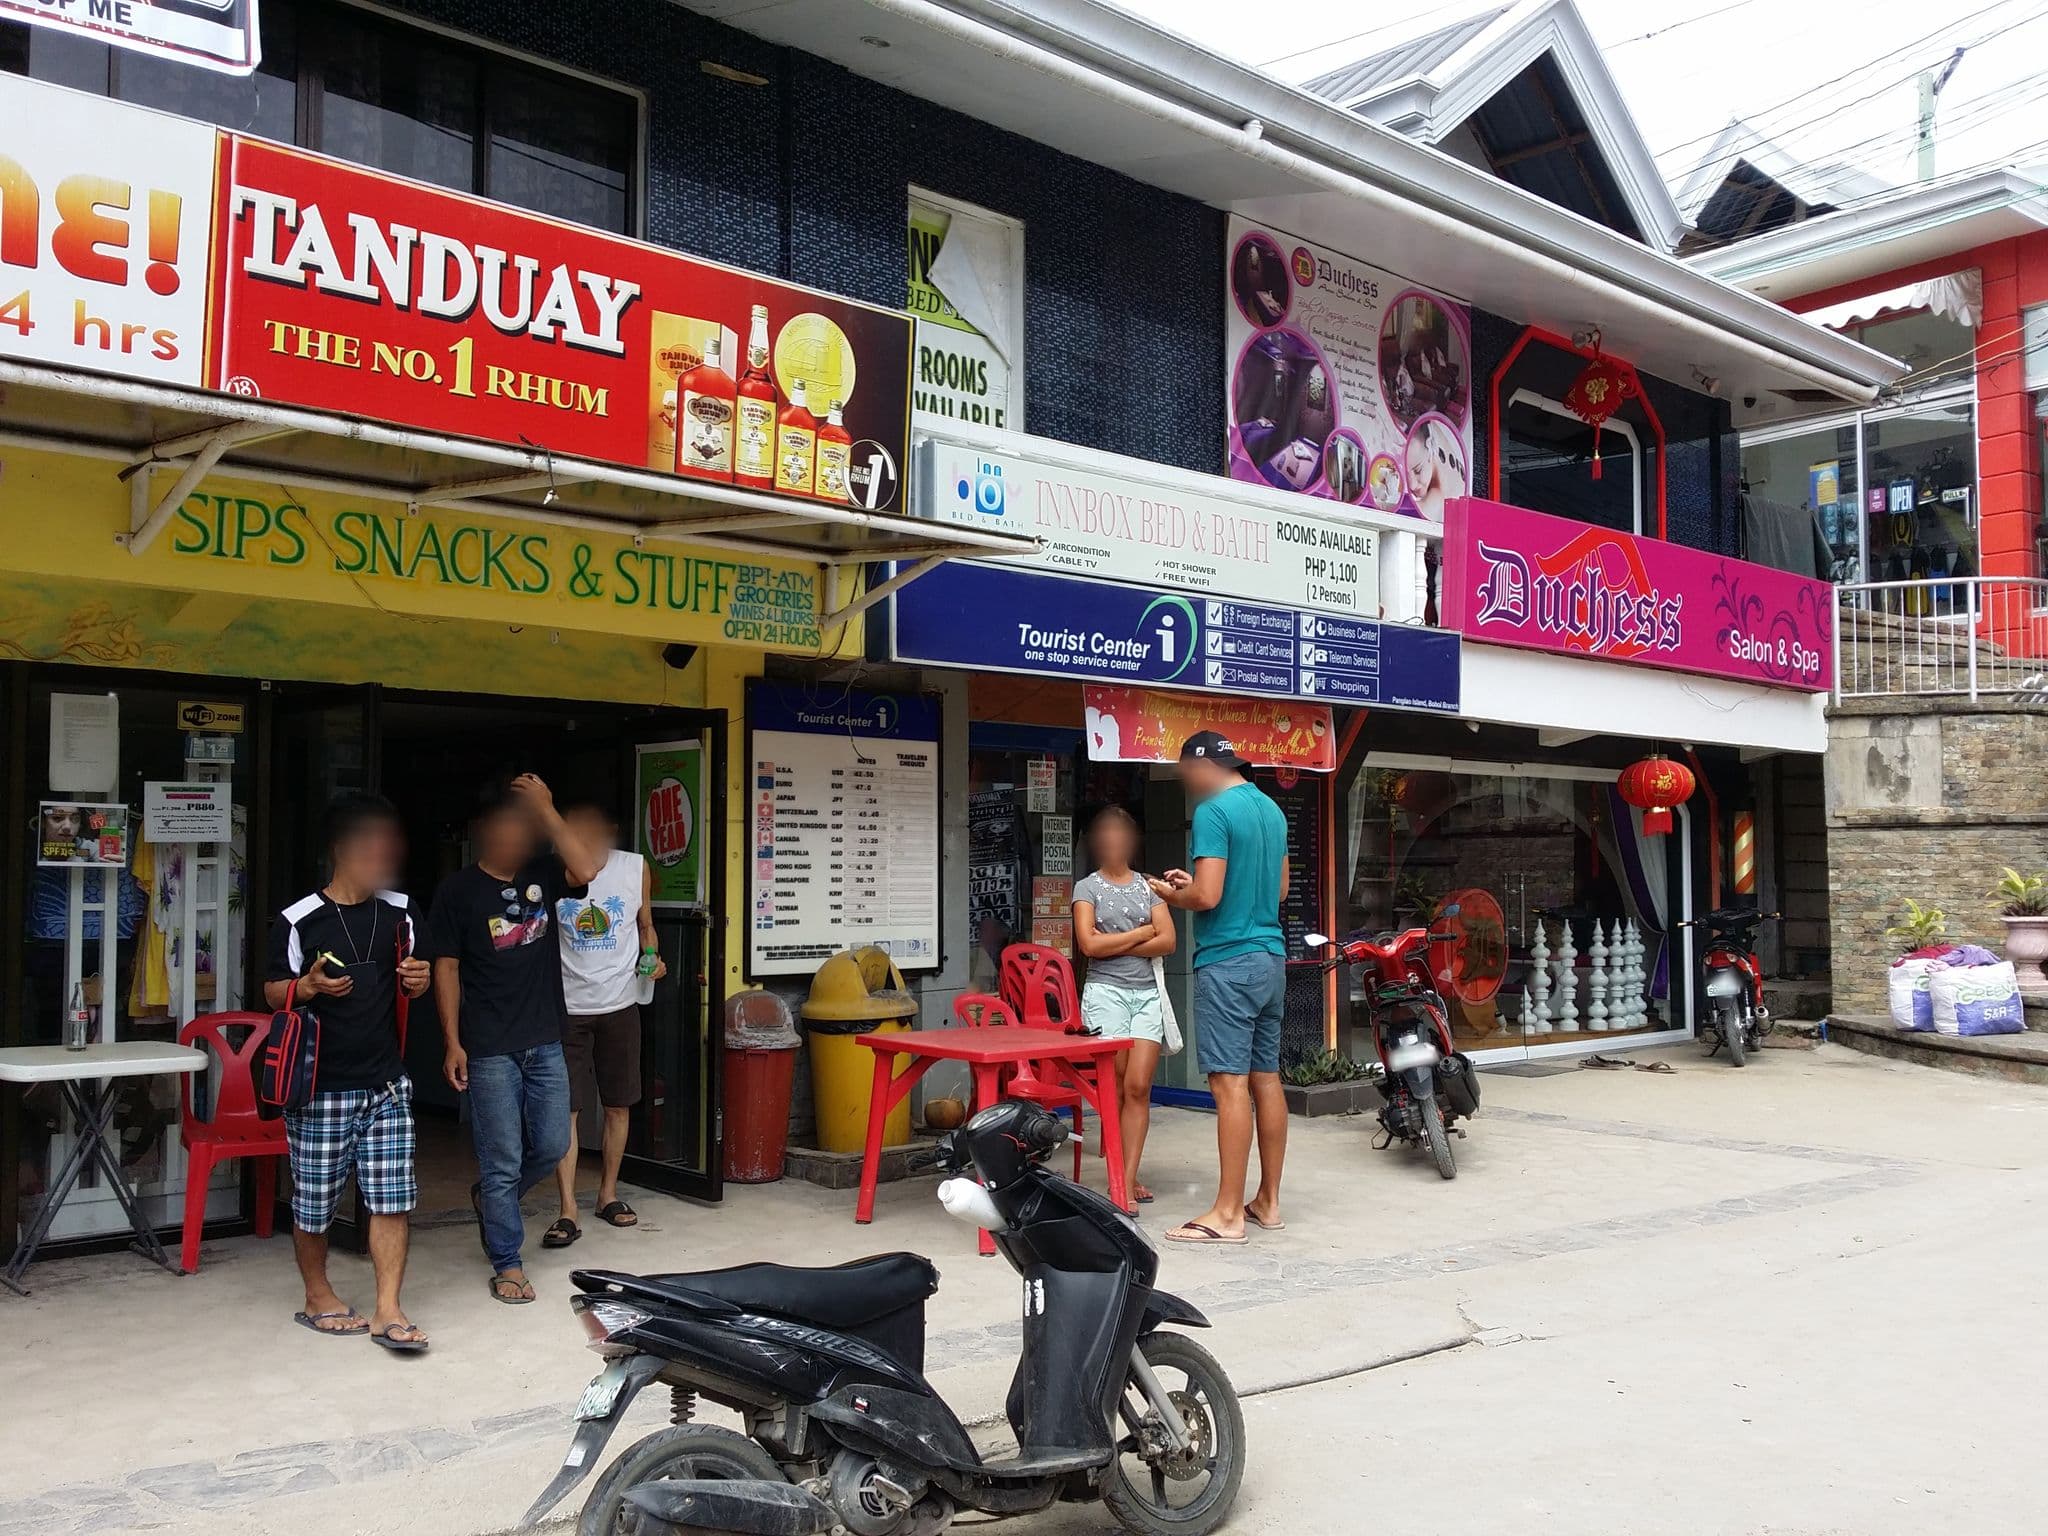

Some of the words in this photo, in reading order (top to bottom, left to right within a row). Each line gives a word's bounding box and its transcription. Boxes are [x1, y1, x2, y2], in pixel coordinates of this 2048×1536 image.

[234, 185, 641, 356] TANDUAY
[1317, 257, 1379, 299] Duchess
[73, 299, 180, 362] hrs
[264, 319, 361, 368] THE
[484, 366, 610, 418] RHUM
[920, 345, 988, 397] ROOMS
[1892, 484, 1914, 512] OPEN
[952, 511, 974, 522] BED
[995, 518, 1025, 529] BATH
[1035, 480, 1134, 541] INNBOX
[1140, 499, 1187, 549] BED
[1193, 510, 1207, 553] &
[1212, 513, 1271, 565] BATH
[1276, 521, 1317, 547] ROOMS
[1319, 529, 1372, 557] AVAILABLE
[173, 493, 308, 566] SIPS
[334, 510, 552, 594] SNACKS
[568, 543, 604, 599] &
[614, 549, 737, 614] STUFF
[1052, 542, 1111, 559] AIRCONDITION
[1052, 555, 1082, 567] CABLE
[1084, 559, 1098, 569] TV
[1162, 560, 1181, 571] HOT
[1181, 563, 1217, 576] SHOWER
[1305, 557, 1327, 578] PHP
[1329, 562, 1358, 585] 1,100
[737, 564, 815, 593] BPI-ATM
[1162, 572, 1187, 584] FREE
[1188, 576, 1210, 587] WIFI
[734, 585, 815, 610] GROCERIES
[1476, 540, 1683, 652] Duchess
[730, 603, 765, 621] WINES
[766, 607, 773, 620] &
[774, 608, 815, 626] LIQUORS
[1236, 610, 1261, 626] Foreign
[1261, 614, 1292, 632] Exchange
[724, 619, 762, 640] OPEN
[763, 624, 777, 643] 24
[780, 625, 820, 648] HOURS
[1018, 624, 1086, 652] Tourist
[1091, 633, 1151, 660] Center
[1328, 624, 1357, 640] Business
[1356, 629, 1378, 642] Center
[1025, 650, 1045, 661] one
[1047, 652, 1070, 666] stop
[1072, 655, 1108, 668] service
[1110, 660, 1141, 672] center
[1237, 640, 1254, 653] Credit
[1255, 643, 1269, 656] Card
[1269, 645, 1292, 660] Services
[1329, 651, 1352, 666] Telecom
[1352, 654, 1377, 669] Services
[1730, 629, 1773, 665] Salon
[1777, 641, 1788, 666] &
[1791, 641, 1820, 682] Spa
[1237, 672, 1259, 683] Postal
[1260, 673, 1288, 687] Services
[1331, 680, 1370, 695] Shopping
[216, 713, 242, 722] ZONE
[797, 712, 835, 725] Tourist
[838, 715, 873, 728] Center
[1218, 701, 1248, 722] Chinese
[896, 753, 928, 761] TRAVELERS
[650, 784, 683, 828] ONE
[1044, 819, 1070, 831] INTERNET
[651, 821, 686, 855] YEAR
[1044, 846, 1070, 858] POSTAL
[1044, 861, 1071, 873] TELECOM
[1041, 882, 1064, 893] SALE
[1041, 924, 1064, 936] SALE
